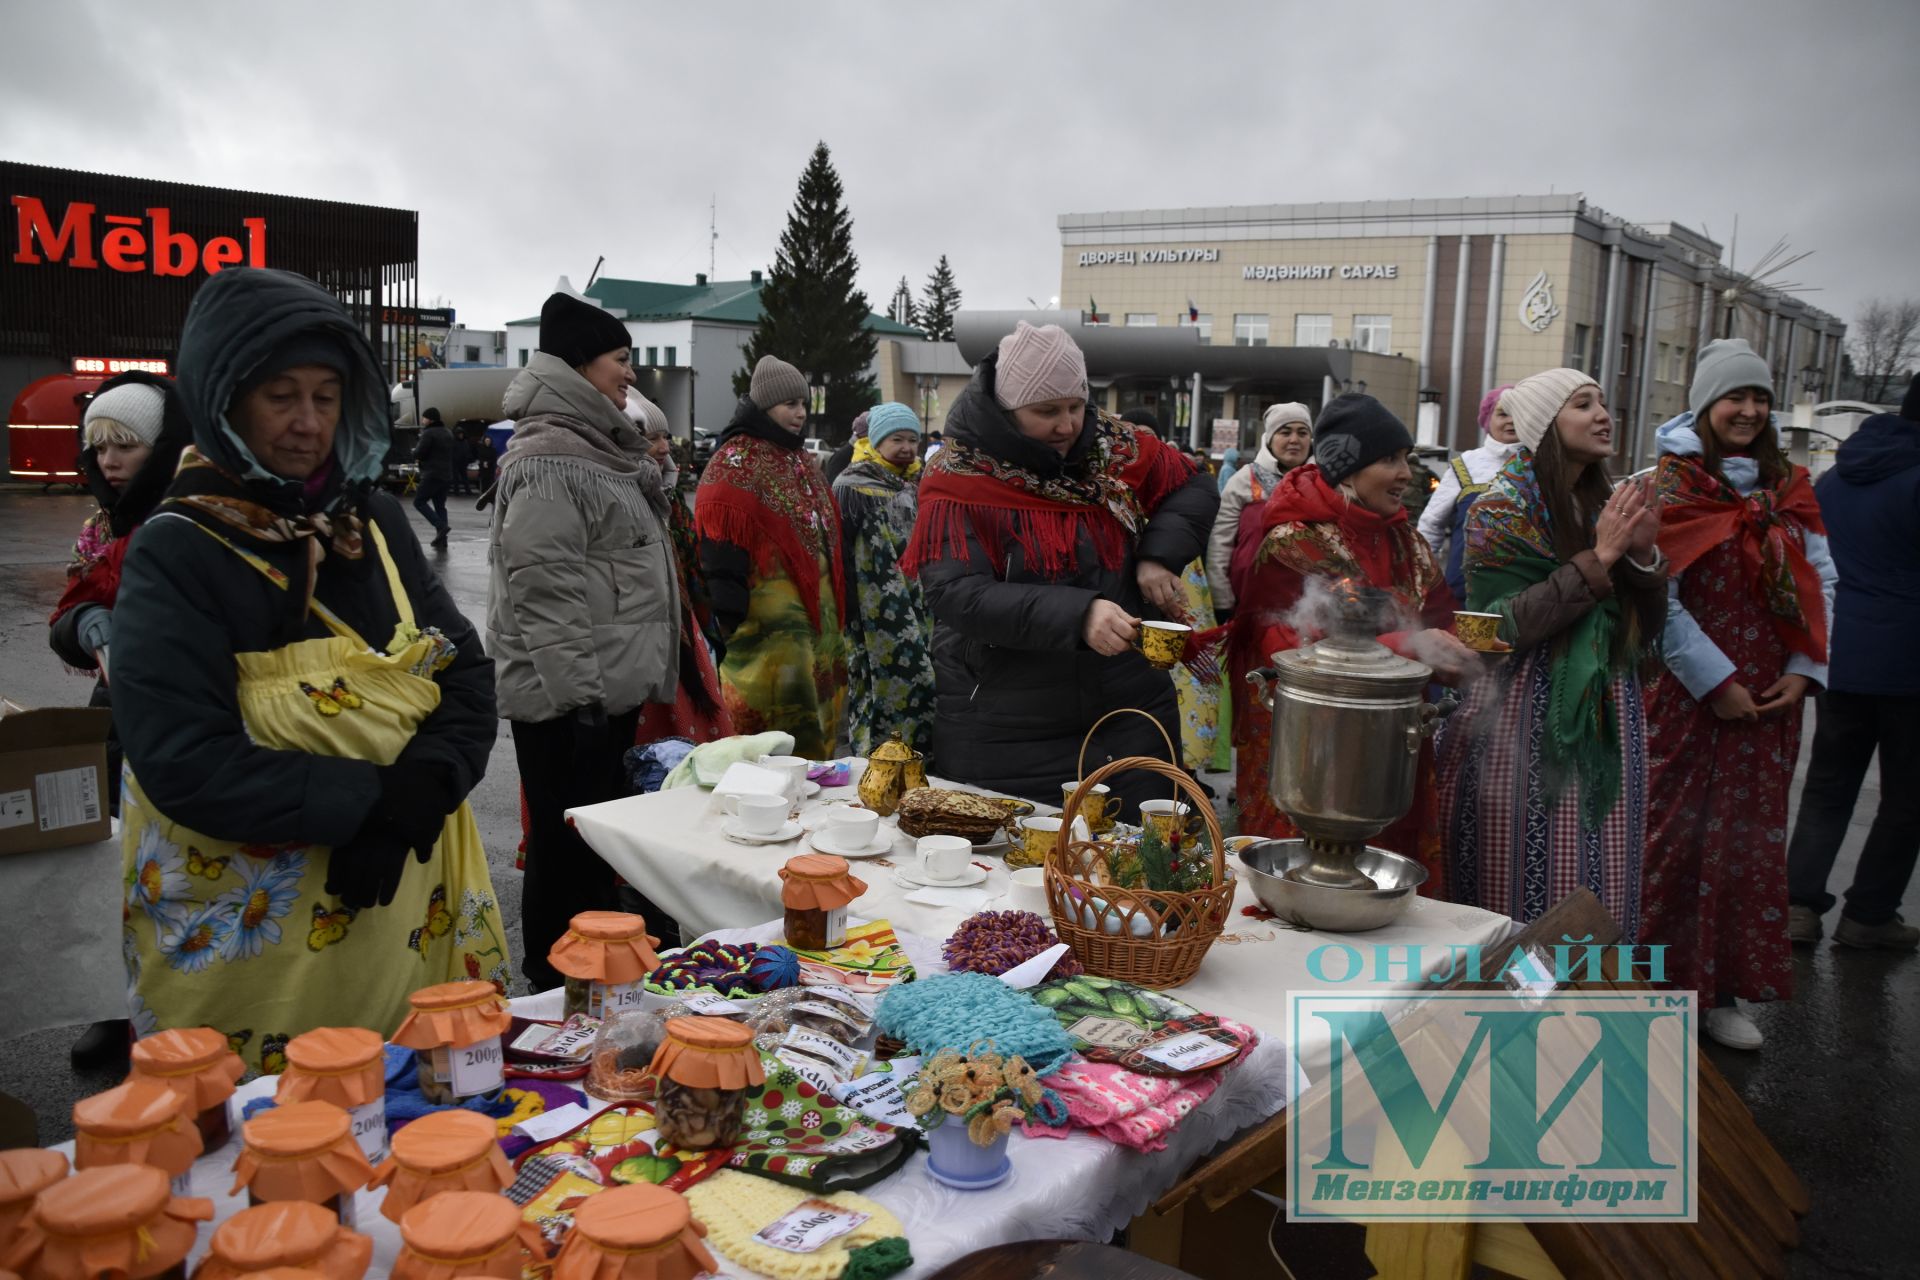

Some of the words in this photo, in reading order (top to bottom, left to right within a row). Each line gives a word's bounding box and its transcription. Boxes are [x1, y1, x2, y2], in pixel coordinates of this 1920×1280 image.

[1079, 250, 1135, 266] ДВОРЕЦ
[1140, 248, 1218, 264] КУЛЬТУРЫ
[1242, 264, 1333, 281] МӘДӘНИЯТ
[1340, 263, 1397, 280] САРАЕ
[75, 359, 105, 372] RED
[109, 360, 167, 374] BURGER
[784, 1210, 837, 1245] 50руб
